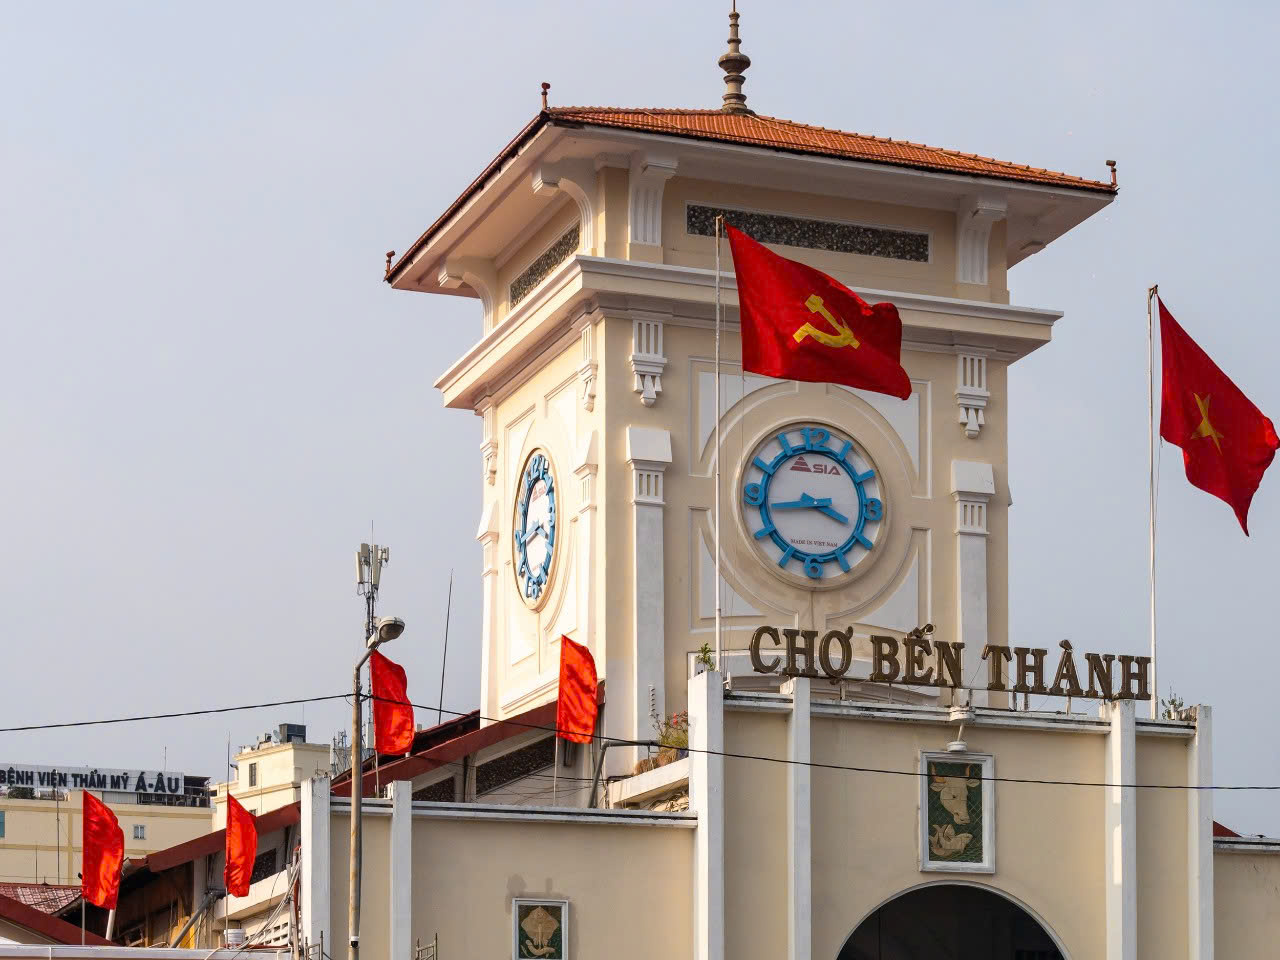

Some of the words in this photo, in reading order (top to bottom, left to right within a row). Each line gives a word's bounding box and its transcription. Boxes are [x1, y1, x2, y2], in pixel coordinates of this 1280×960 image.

[801, 427, 831, 451] 12
[744, 483, 766, 506] 9
[864, 498, 883, 521] 3
[749, 625, 855, 685] CHỢ
[869, 622, 966, 688] BẾN
[980, 638, 1153, 700] THÀNH
[0, 766, 35, 787] BỆNH
[38, 768, 68, 788] VIỆN
[71, 769, 107, 789] THẨM
[110, 772, 130, 791] MỸ
[134, 771, 181, 794] Á-ÂU
